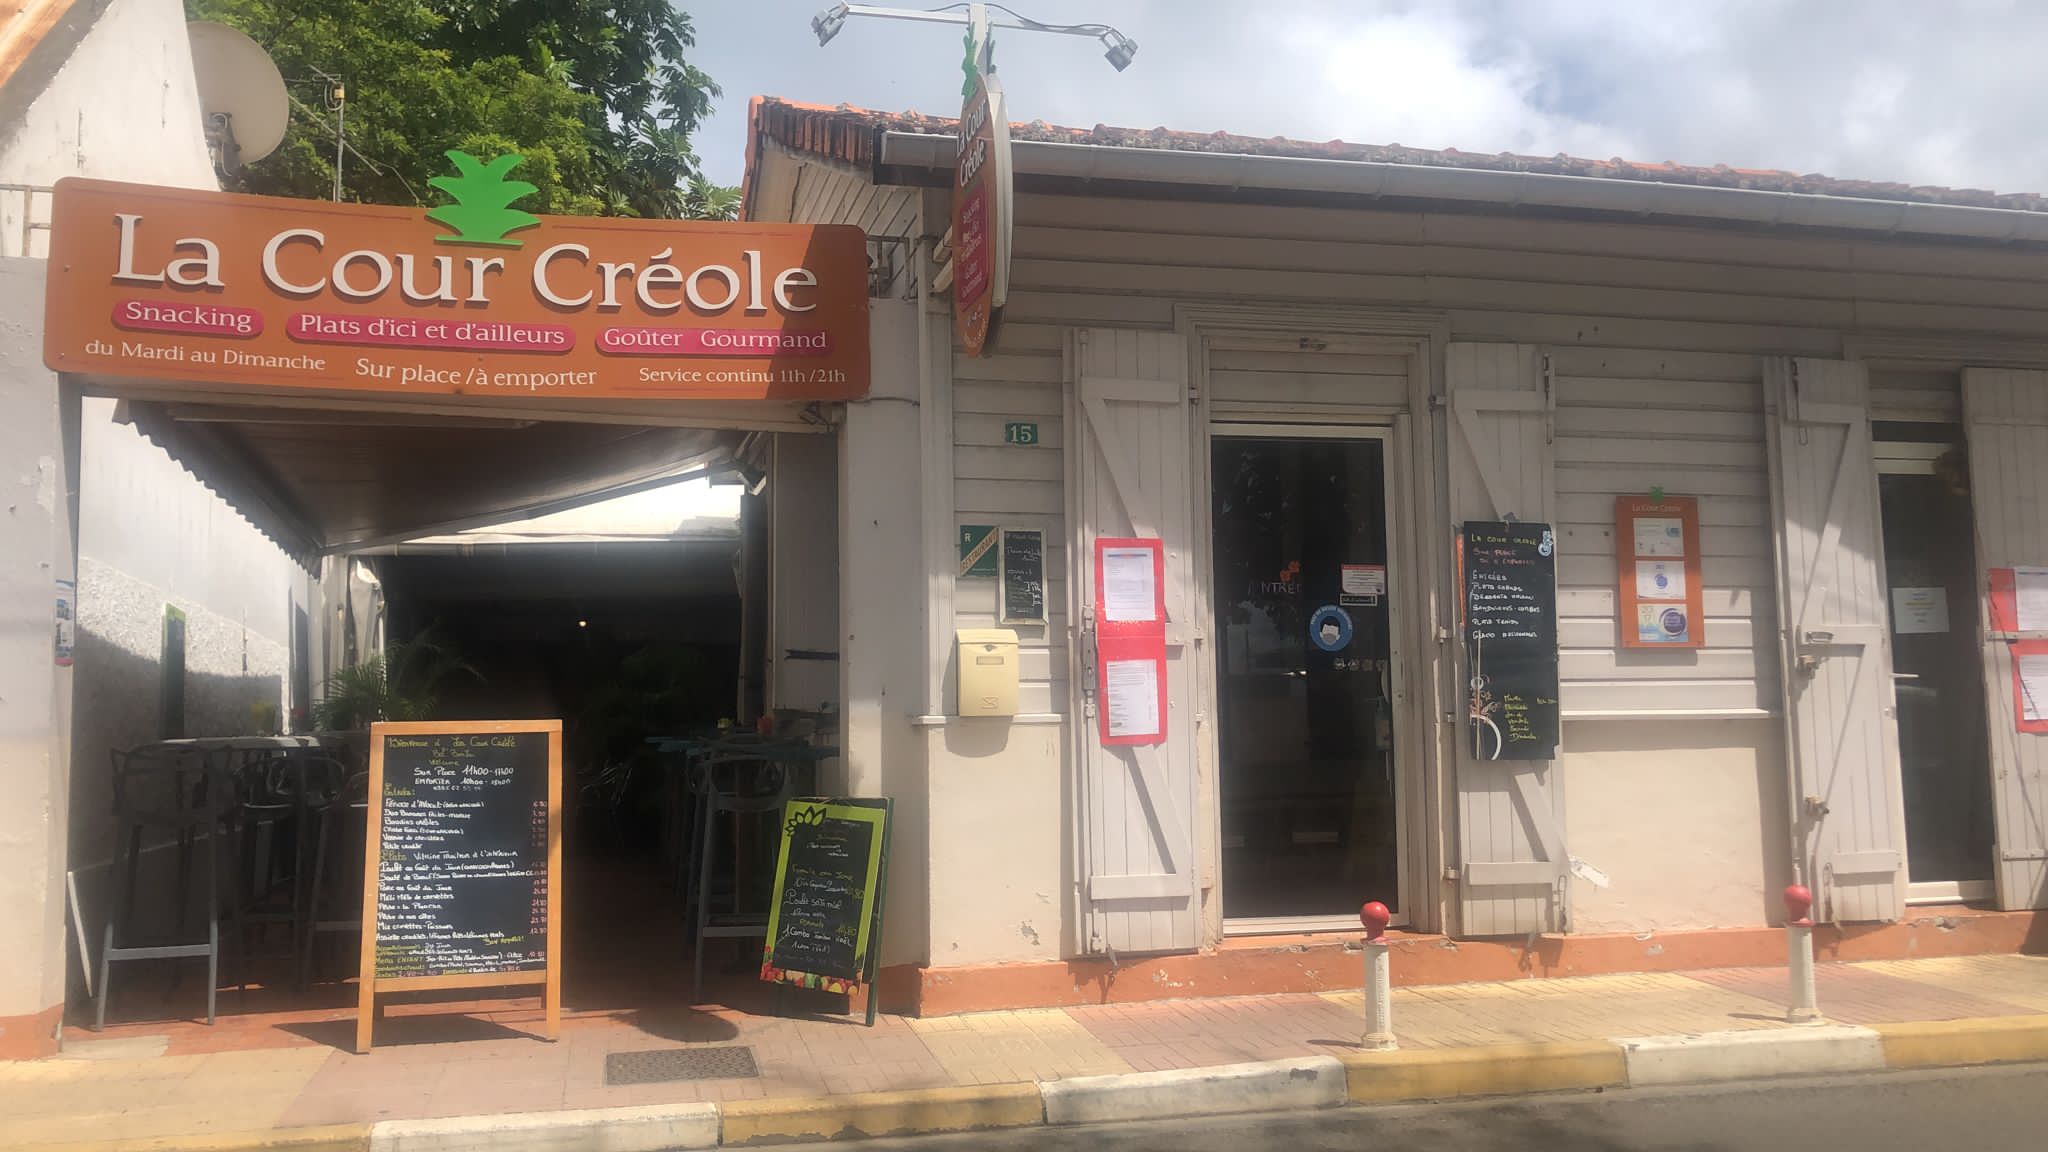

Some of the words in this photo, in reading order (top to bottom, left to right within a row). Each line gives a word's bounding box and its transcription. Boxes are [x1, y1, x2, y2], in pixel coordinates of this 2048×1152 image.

[956, 130, 966, 158] La
[966, 99, 986, 143] Cour
[111, 213, 225, 288] La
[262, 228, 504, 302] Cour
[533, 242, 818, 312] Créole
[126, 302, 252, 333] Snacking
[300, 315, 361, 336] Plats
[368, 317, 418, 338] d'ici
[424, 321, 449, 339] et
[455, 322, 564, 345] d'ailleurs
[604, 328, 684, 347] Goûter
[700, 329, 826, 349] Gourmand
[86, 339, 113, 355] du
[121, 341, 184, 361] Mardi
[191, 347, 216, 364] au
[224, 349, 326, 371] Dimanche
[356, 358, 395, 379] Sur
[402, 361, 461, 385] place
[494, 369, 597, 391] emporter
[639, 367, 702, 383] Service
[706, 368, 774, 384] continu
[1010, 425, 1032, 443] 15
